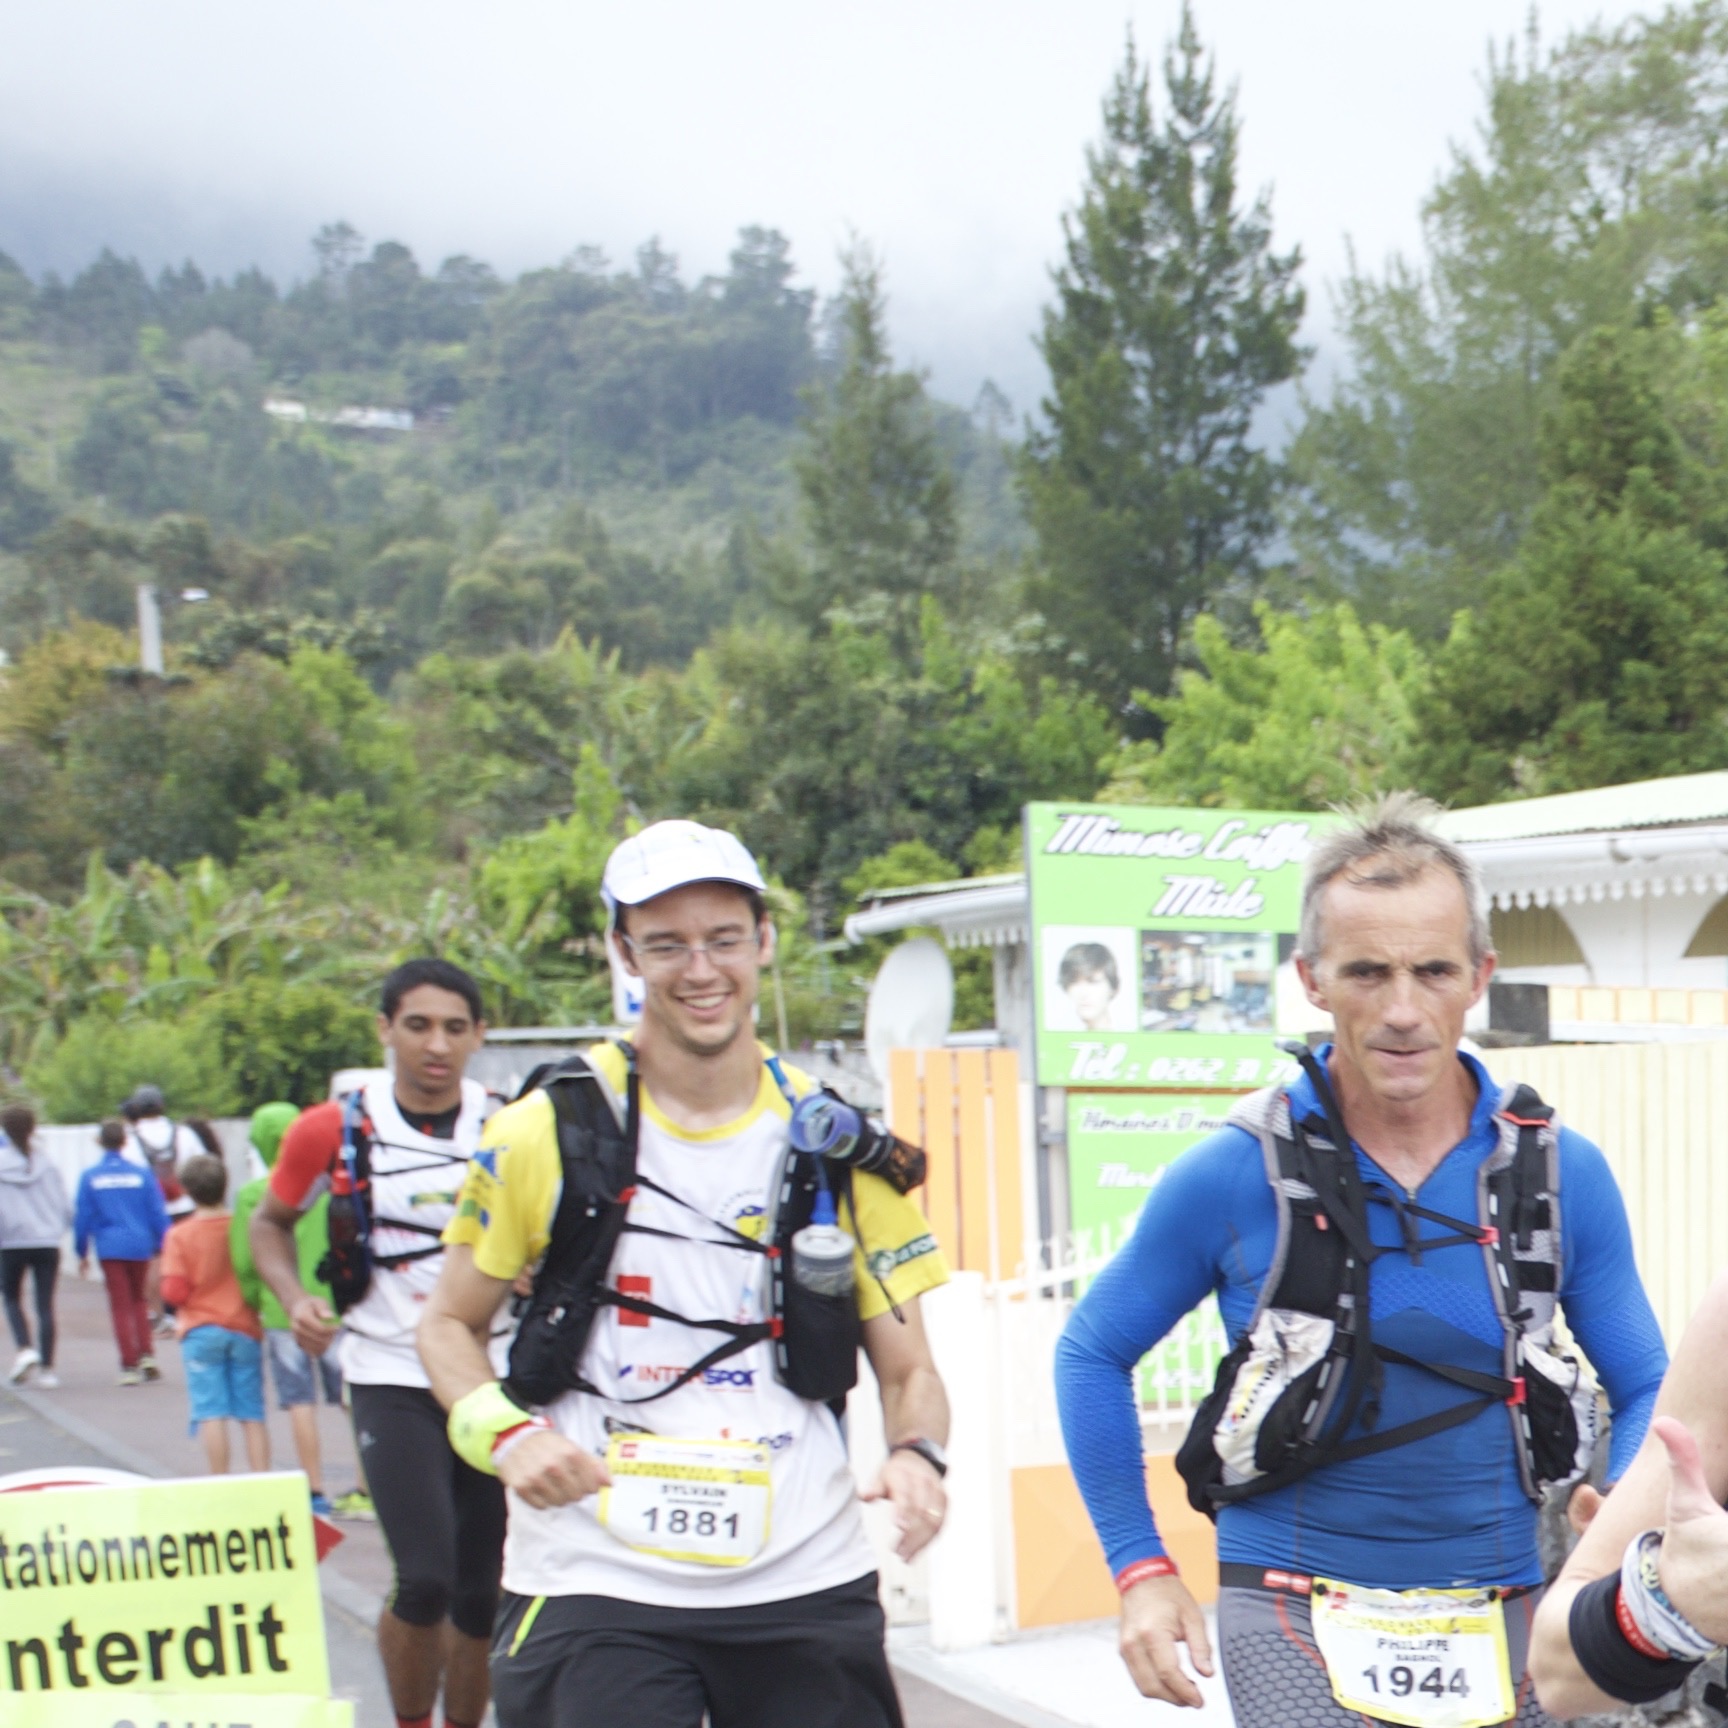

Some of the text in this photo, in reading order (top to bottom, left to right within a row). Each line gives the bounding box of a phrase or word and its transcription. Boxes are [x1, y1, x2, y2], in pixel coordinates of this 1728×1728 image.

[642, 1506, 739, 1540] 1881
[5, 1602, 289, 1692] nterdit
[1362, 1665, 1470, 1699] 1944
